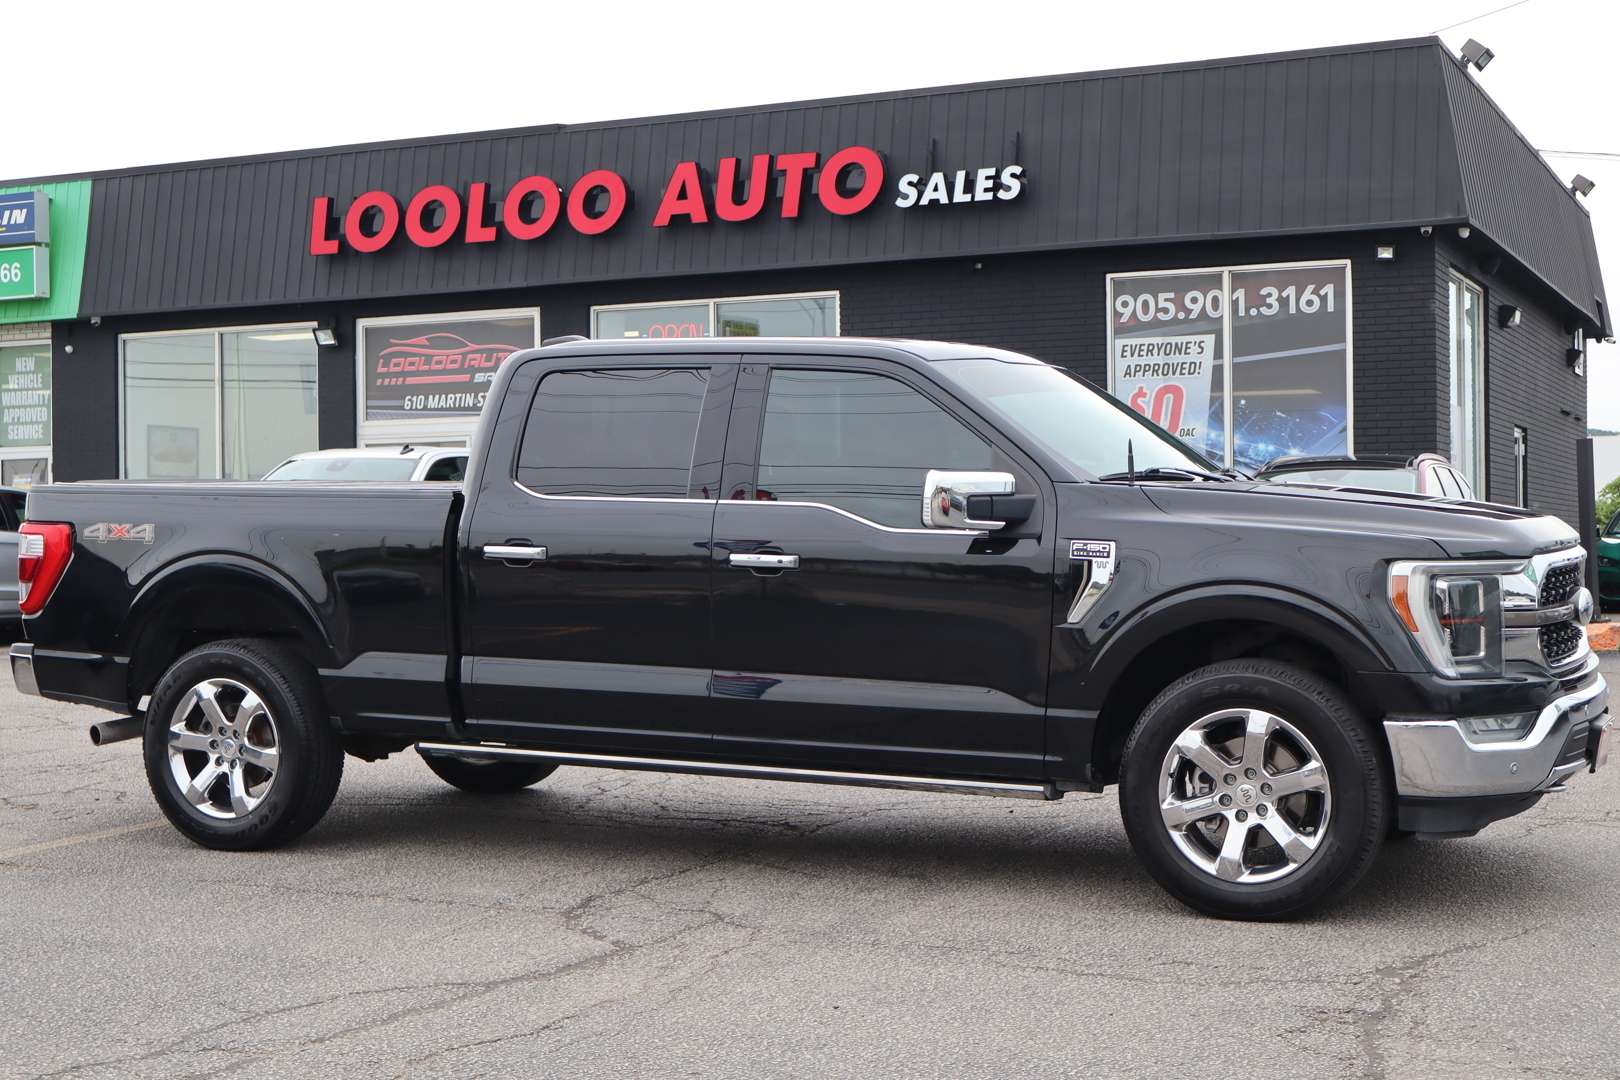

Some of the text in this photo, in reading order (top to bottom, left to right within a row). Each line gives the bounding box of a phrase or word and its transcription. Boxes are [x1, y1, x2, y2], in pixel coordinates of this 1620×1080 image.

[310, 146, 1024, 256] LOOLOO AUTO SALES
[0, 208, 27, 225] IN
[1115, 284, 1335, 323] 905.901.3161
[1120, 341, 1205, 359] EVERYONE'S
[15, 357, 35, 372] NEW
[376, 352, 511, 373] LOOLOO AUT
[1123, 361, 1203, 378] APPROVED!
[8, 373, 43, 389] VEHICLE
[1, 390, 49, 406] WARRANTY
[404, 395, 426, 410] 610
[428, 393, 475, 408] MARTIN
[4, 408, 48, 424] APPROVED
[8, 424, 43, 440] SERVICE
[1073, 543, 1110, 551] F-150
